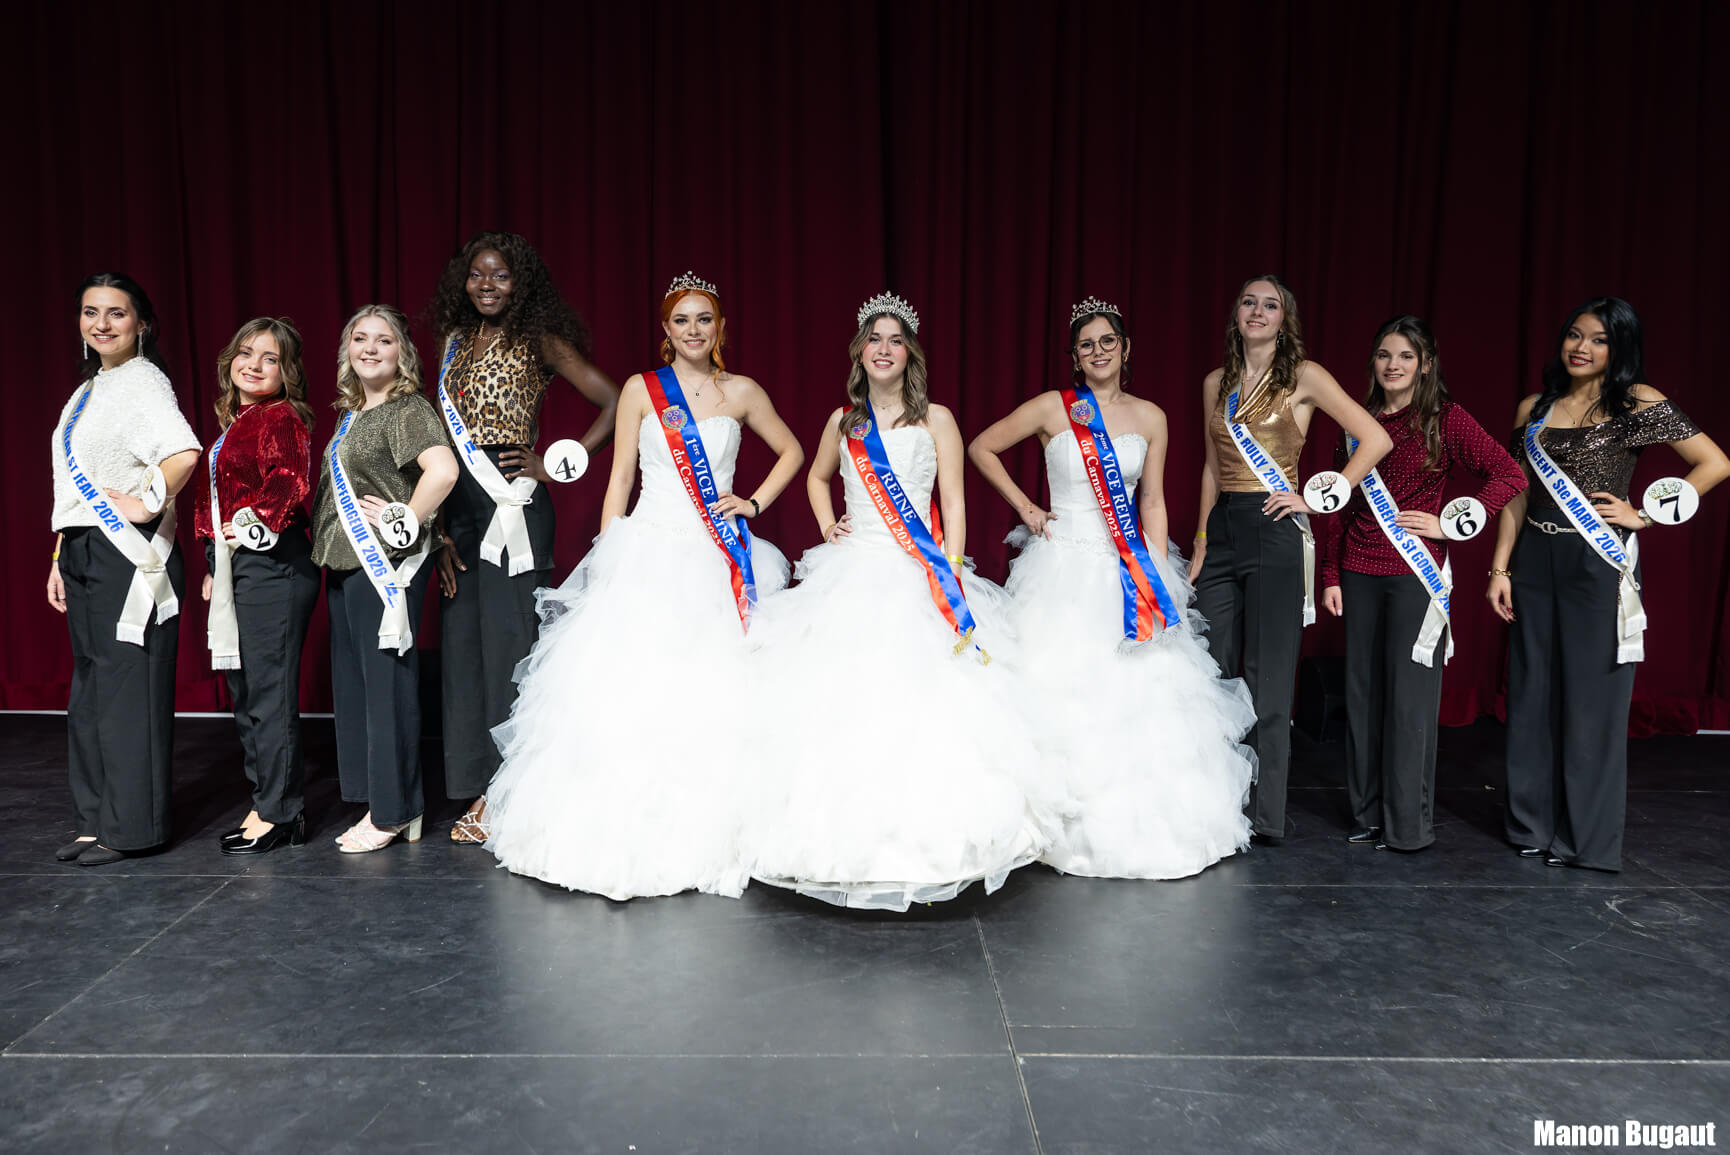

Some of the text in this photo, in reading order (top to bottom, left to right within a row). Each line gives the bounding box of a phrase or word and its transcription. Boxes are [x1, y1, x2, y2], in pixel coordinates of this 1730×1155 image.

[445, 405, 465, 436] 2026
[672, 448, 685, 465] du
[1231, 423, 1244, 440] de
[1240, 437, 1269, 469] RULLY
[68, 456, 79, 473] ST
[555, 456, 577, 481] 4
[73, 472, 99, 502] JEAN
[694, 457, 715, 498] VICE
[706, 501, 737, 549] REINE
[880, 472, 918, 523] REINE
[1080, 439, 1121, 538] du Carnaval 2025
[1102, 452, 1121, 491] VICE
[1112, 493, 1137, 541] REINE
[1320, 484, 1340, 512] 5
[93, 500, 125, 534] 2026
[855, 456, 915, 552] du Carnaval 2025
[1659, 494, 1680, 522] 7
[249, 524, 272, 549] 2
[393, 520, 412, 547] 3
[1455, 511, 1478, 537] 6
[1565, 496, 1601, 534] MARIE
[1594, 532, 1627, 563] 2026
[362, 545, 388, 578] 2026
[1411, 551, 1445, 594] GOBAIN
